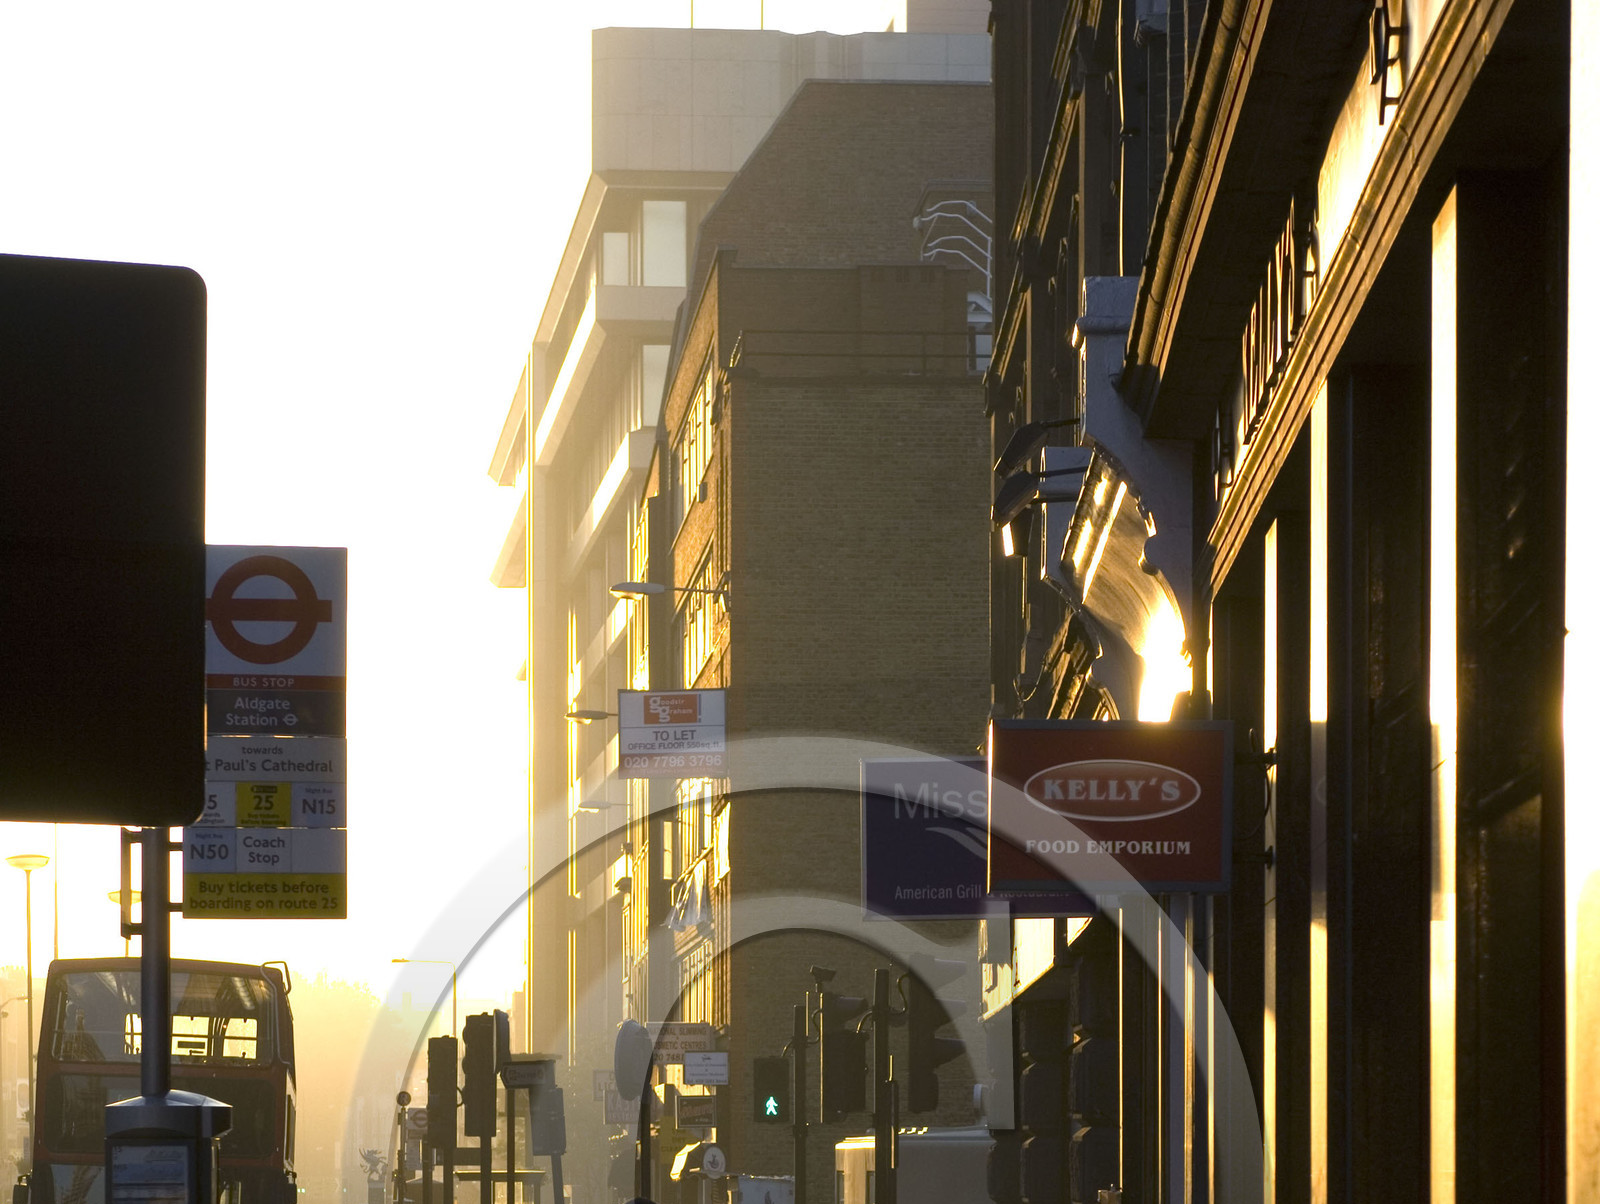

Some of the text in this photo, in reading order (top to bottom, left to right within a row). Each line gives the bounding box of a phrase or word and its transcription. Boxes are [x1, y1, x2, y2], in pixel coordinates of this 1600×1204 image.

[233, 677, 295, 687] BUS STOP
[234, 697, 290, 712] Aldgate
[226, 714, 278, 726] Station
[653, 730, 696, 741] TO LET
[242, 746, 283, 754] towards
[628, 742, 656, 750] OFFICE
[658, 742, 684, 750] FLOOR
[205, 759, 333, 772] t Paul's Cathedral
[624, 755, 722, 768] 020 7796 3796
[1043, 778, 1181, 802] KELLY'S
[207, 795, 217, 810] 5
[253, 795, 274, 811] 25
[302, 799, 336, 814] N15
[893, 782, 988, 820] Miss
[243, 836, 285, 849] Coach
[1026, 840, 1191, 855] FOOD EMPORIUM
[190, 845, 229, 860] N50
[248, 851, 279, 864] Stop
[199, 881, 329, 895] Buy tickets before
[895, 885, 953, 900] American
[956, 884, 982, 899] Grill
[190, 898, 337, 912] boarding on route 25
